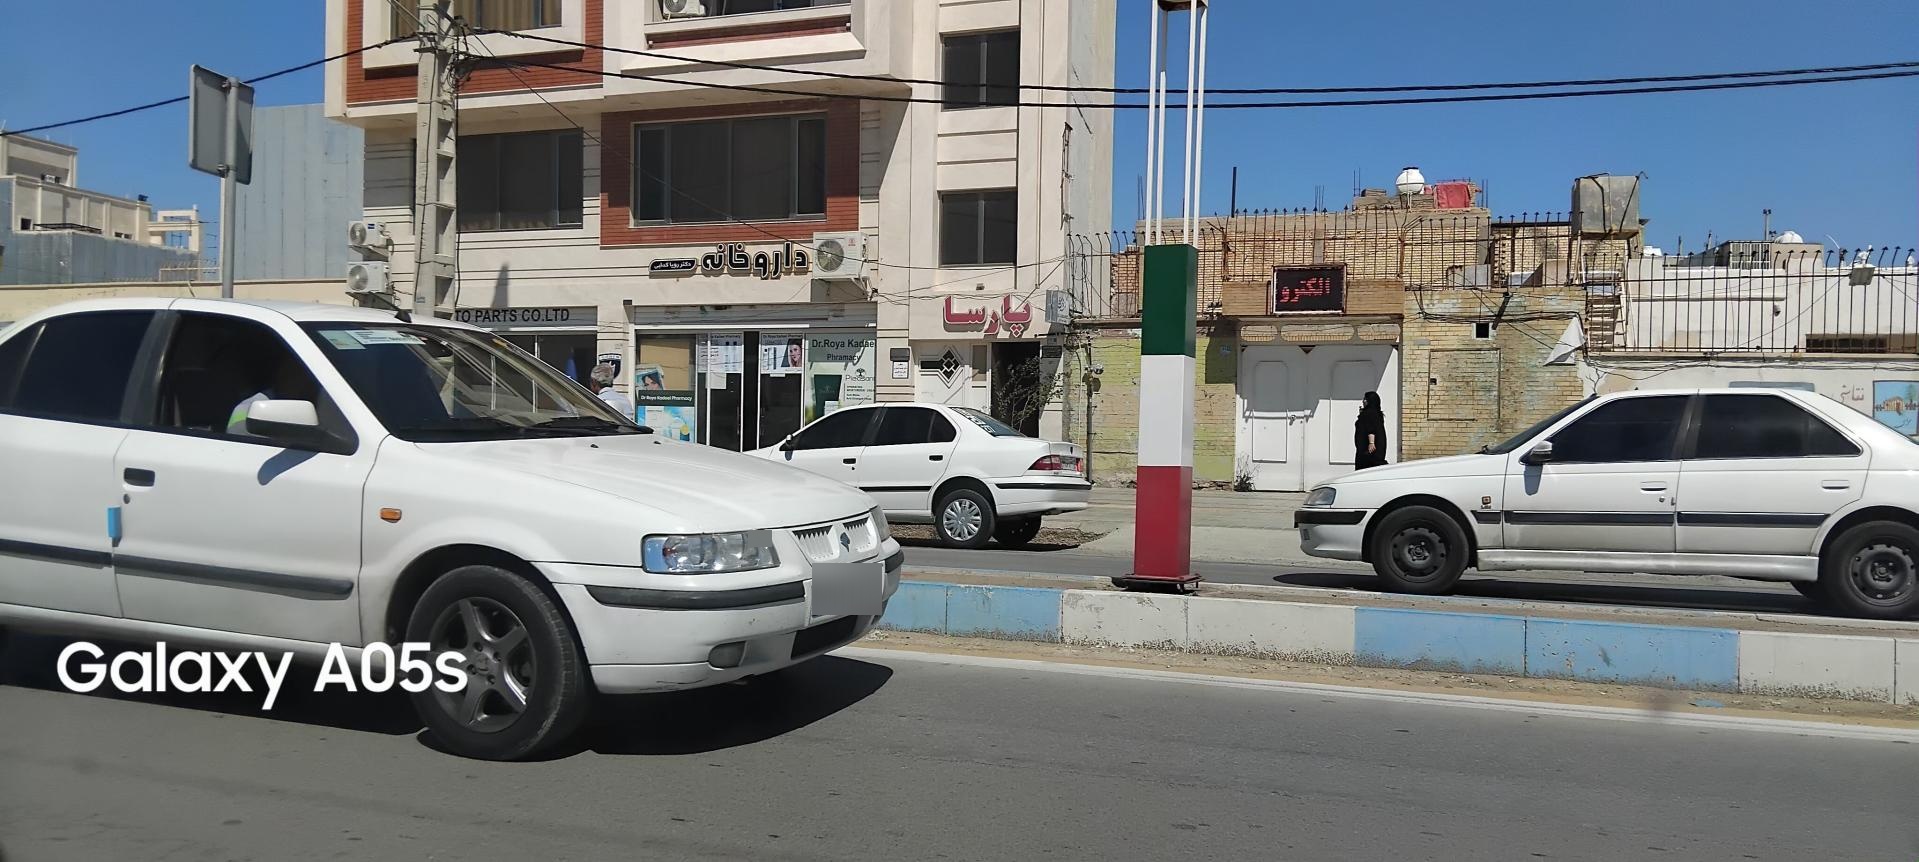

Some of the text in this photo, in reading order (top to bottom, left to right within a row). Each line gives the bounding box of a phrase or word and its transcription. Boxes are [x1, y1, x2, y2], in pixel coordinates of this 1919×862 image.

[701, 241, 808, 278] داروخانه
[454, 308, 570, 323] TO PARTS CO.LTD
[943, 294, 1032, 337] پارسا
[811, 339, 876, 349] Dr.Roya Kadae
[826, 353, 861, 362] Phramacy
